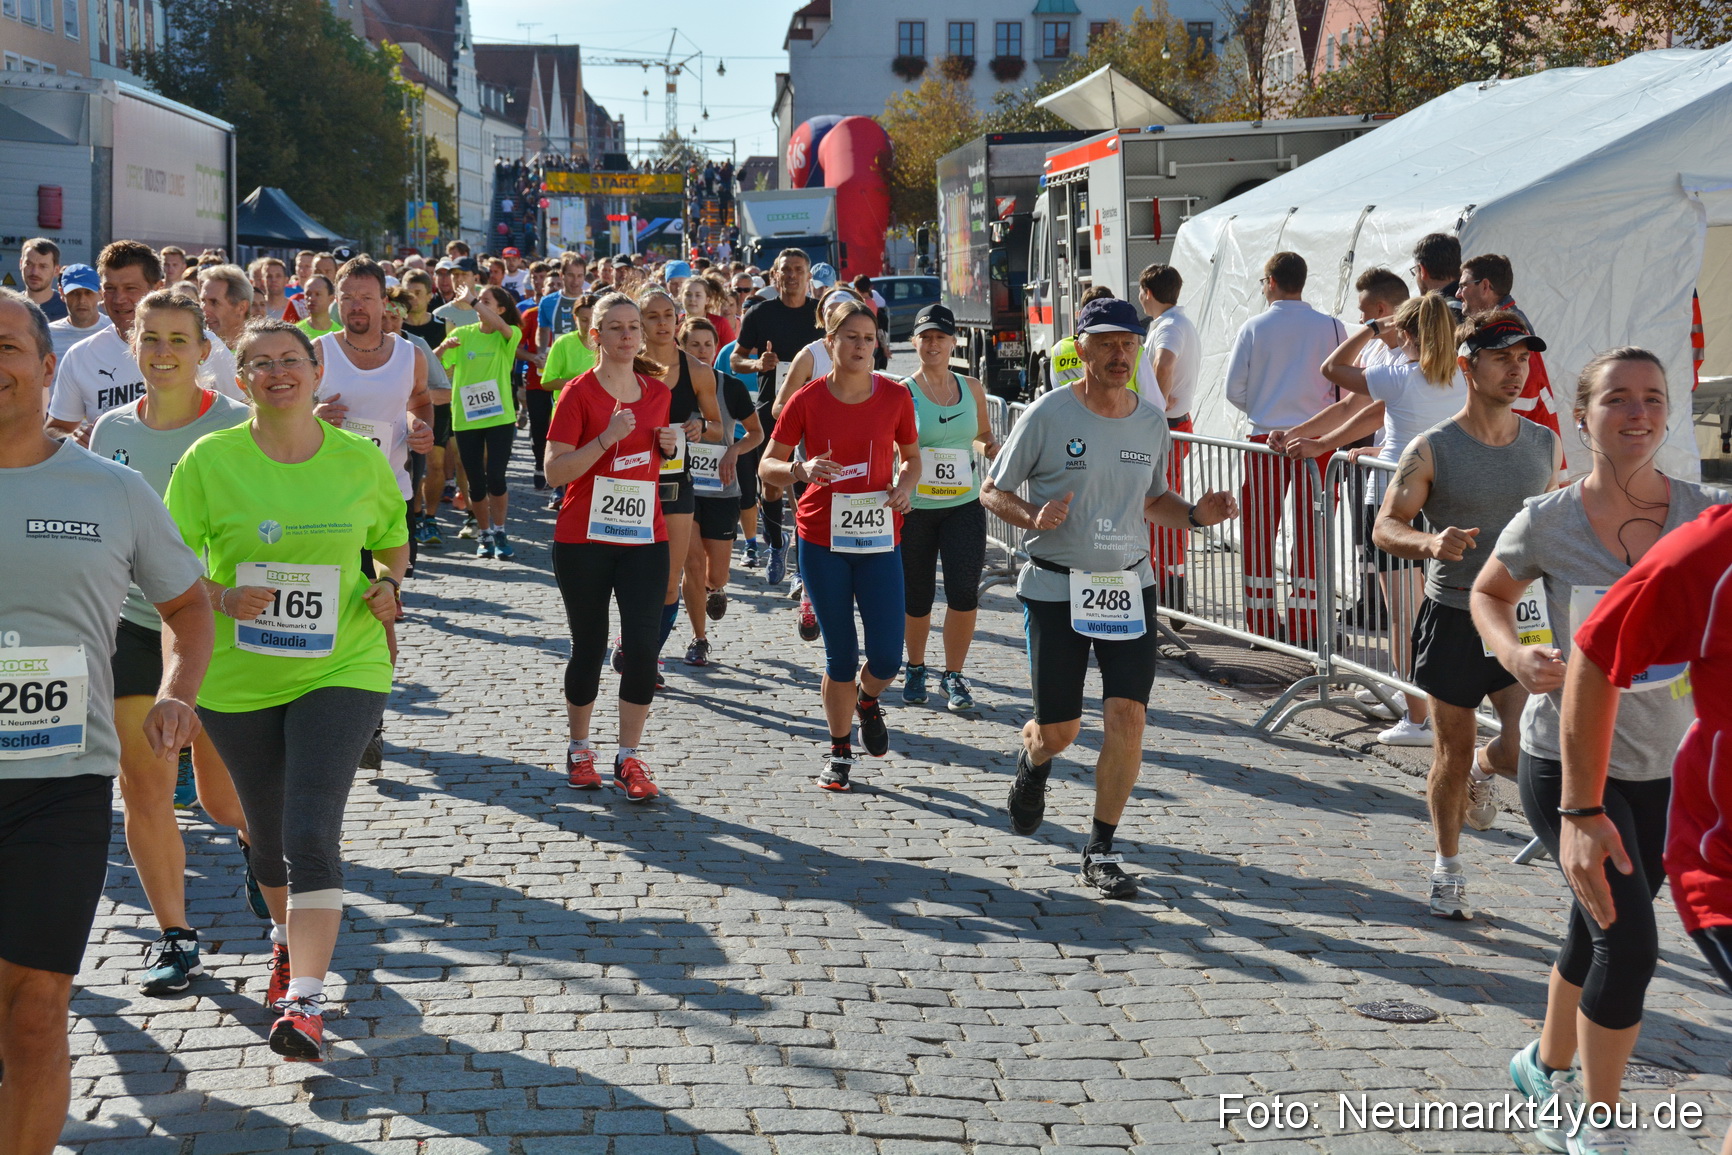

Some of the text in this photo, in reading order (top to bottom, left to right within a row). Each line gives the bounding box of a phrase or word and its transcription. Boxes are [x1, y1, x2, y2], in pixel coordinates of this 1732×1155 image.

[591, 177, 639, 189] START
[767, 212, 810, 222] BOCK
[467, 391, 495, 406] 2168
[1120, 450, 1151, 463] BOCK
[935, 463, 955, 479] 63
[931, 487, 957, 495] Sabrina
[601, 495, 646, 517] 2460
[841, 509, 885, 528] 2443
[1096, 518, 1117, 532] 19.
[27, 519, 100, 537] BOCK
[605, 526, 638, 536] Christina
[267, 570, 311, 583] BOCK
[1092, 576, 1124, 584] BOCK
[260, 589, 323, 619] 165
[1081, 588, 1132, 611] 2488
[255, 619, 307, 629] PARTL Neumarkt
[1088, 622, 1128, 634] Wolfgang
[261, 632, 307, 648] Claudia
[8, 718, 48, 726] Neumarkt
